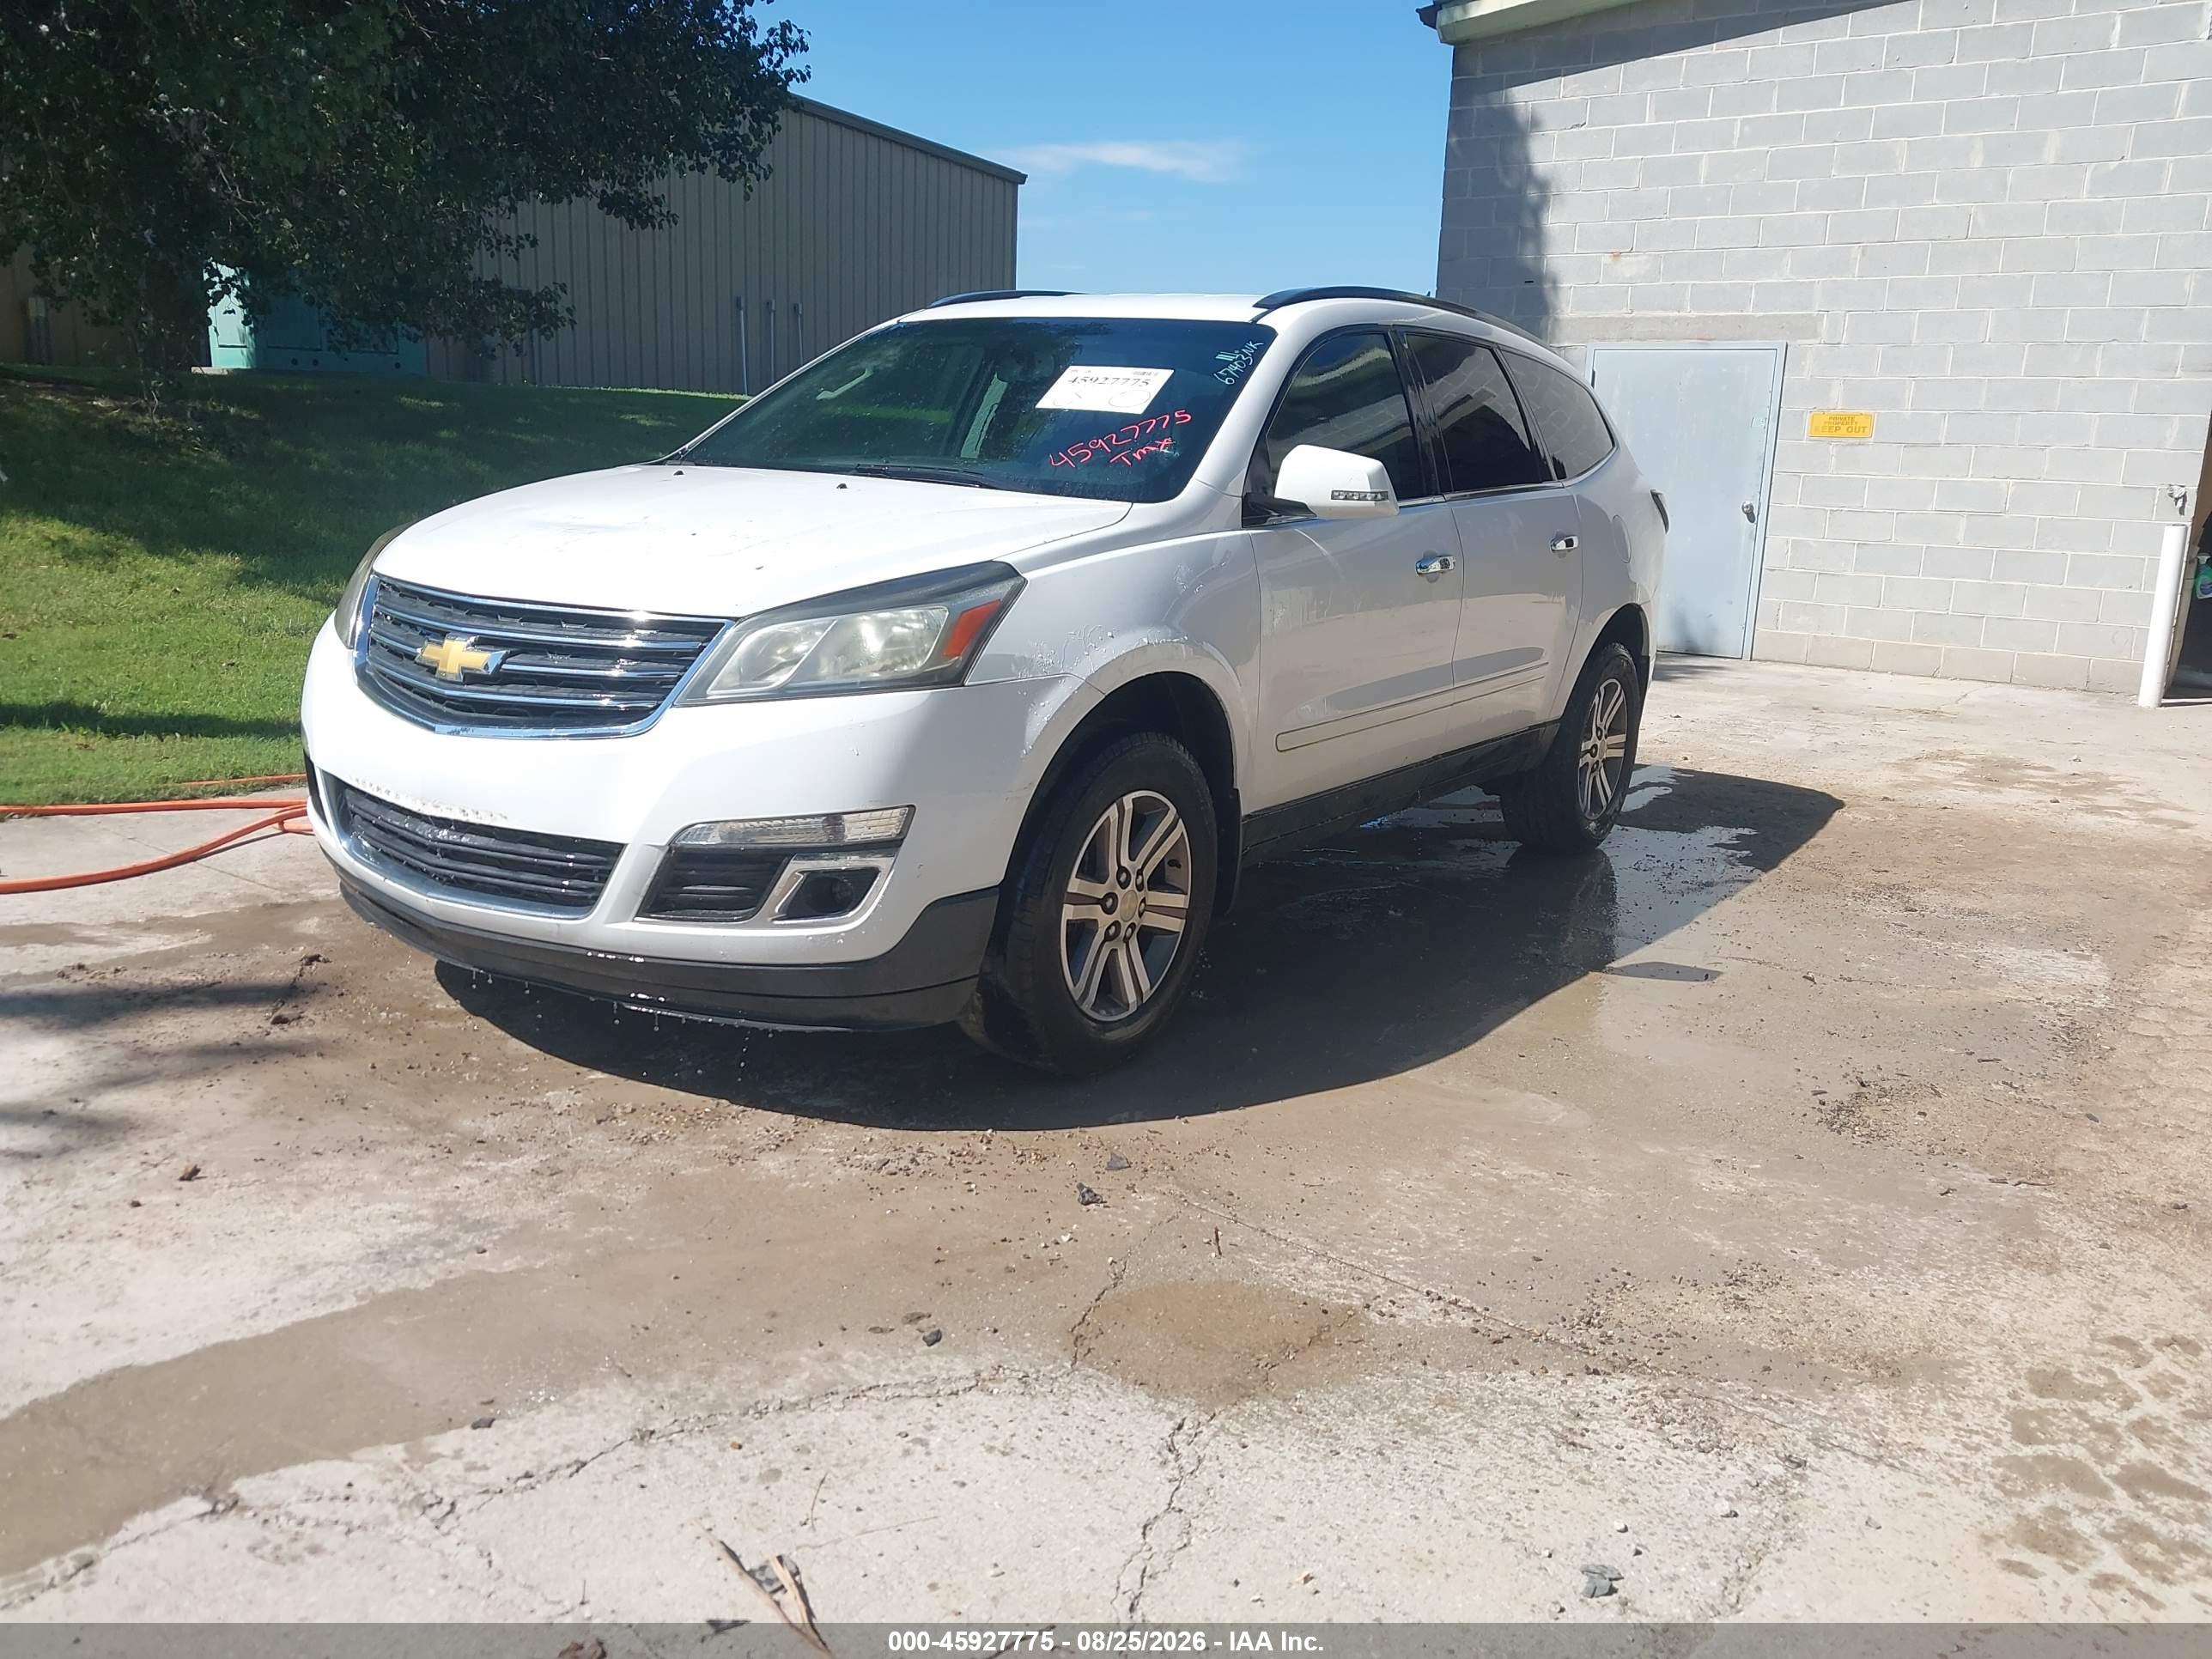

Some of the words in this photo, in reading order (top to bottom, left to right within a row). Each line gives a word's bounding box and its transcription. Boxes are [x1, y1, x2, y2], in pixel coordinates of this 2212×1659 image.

[1066, 375, 1152, 387] 45927775
[1814, 425, 1842, 434] EEP
[1048, 409, 1193, 468] 45927775
